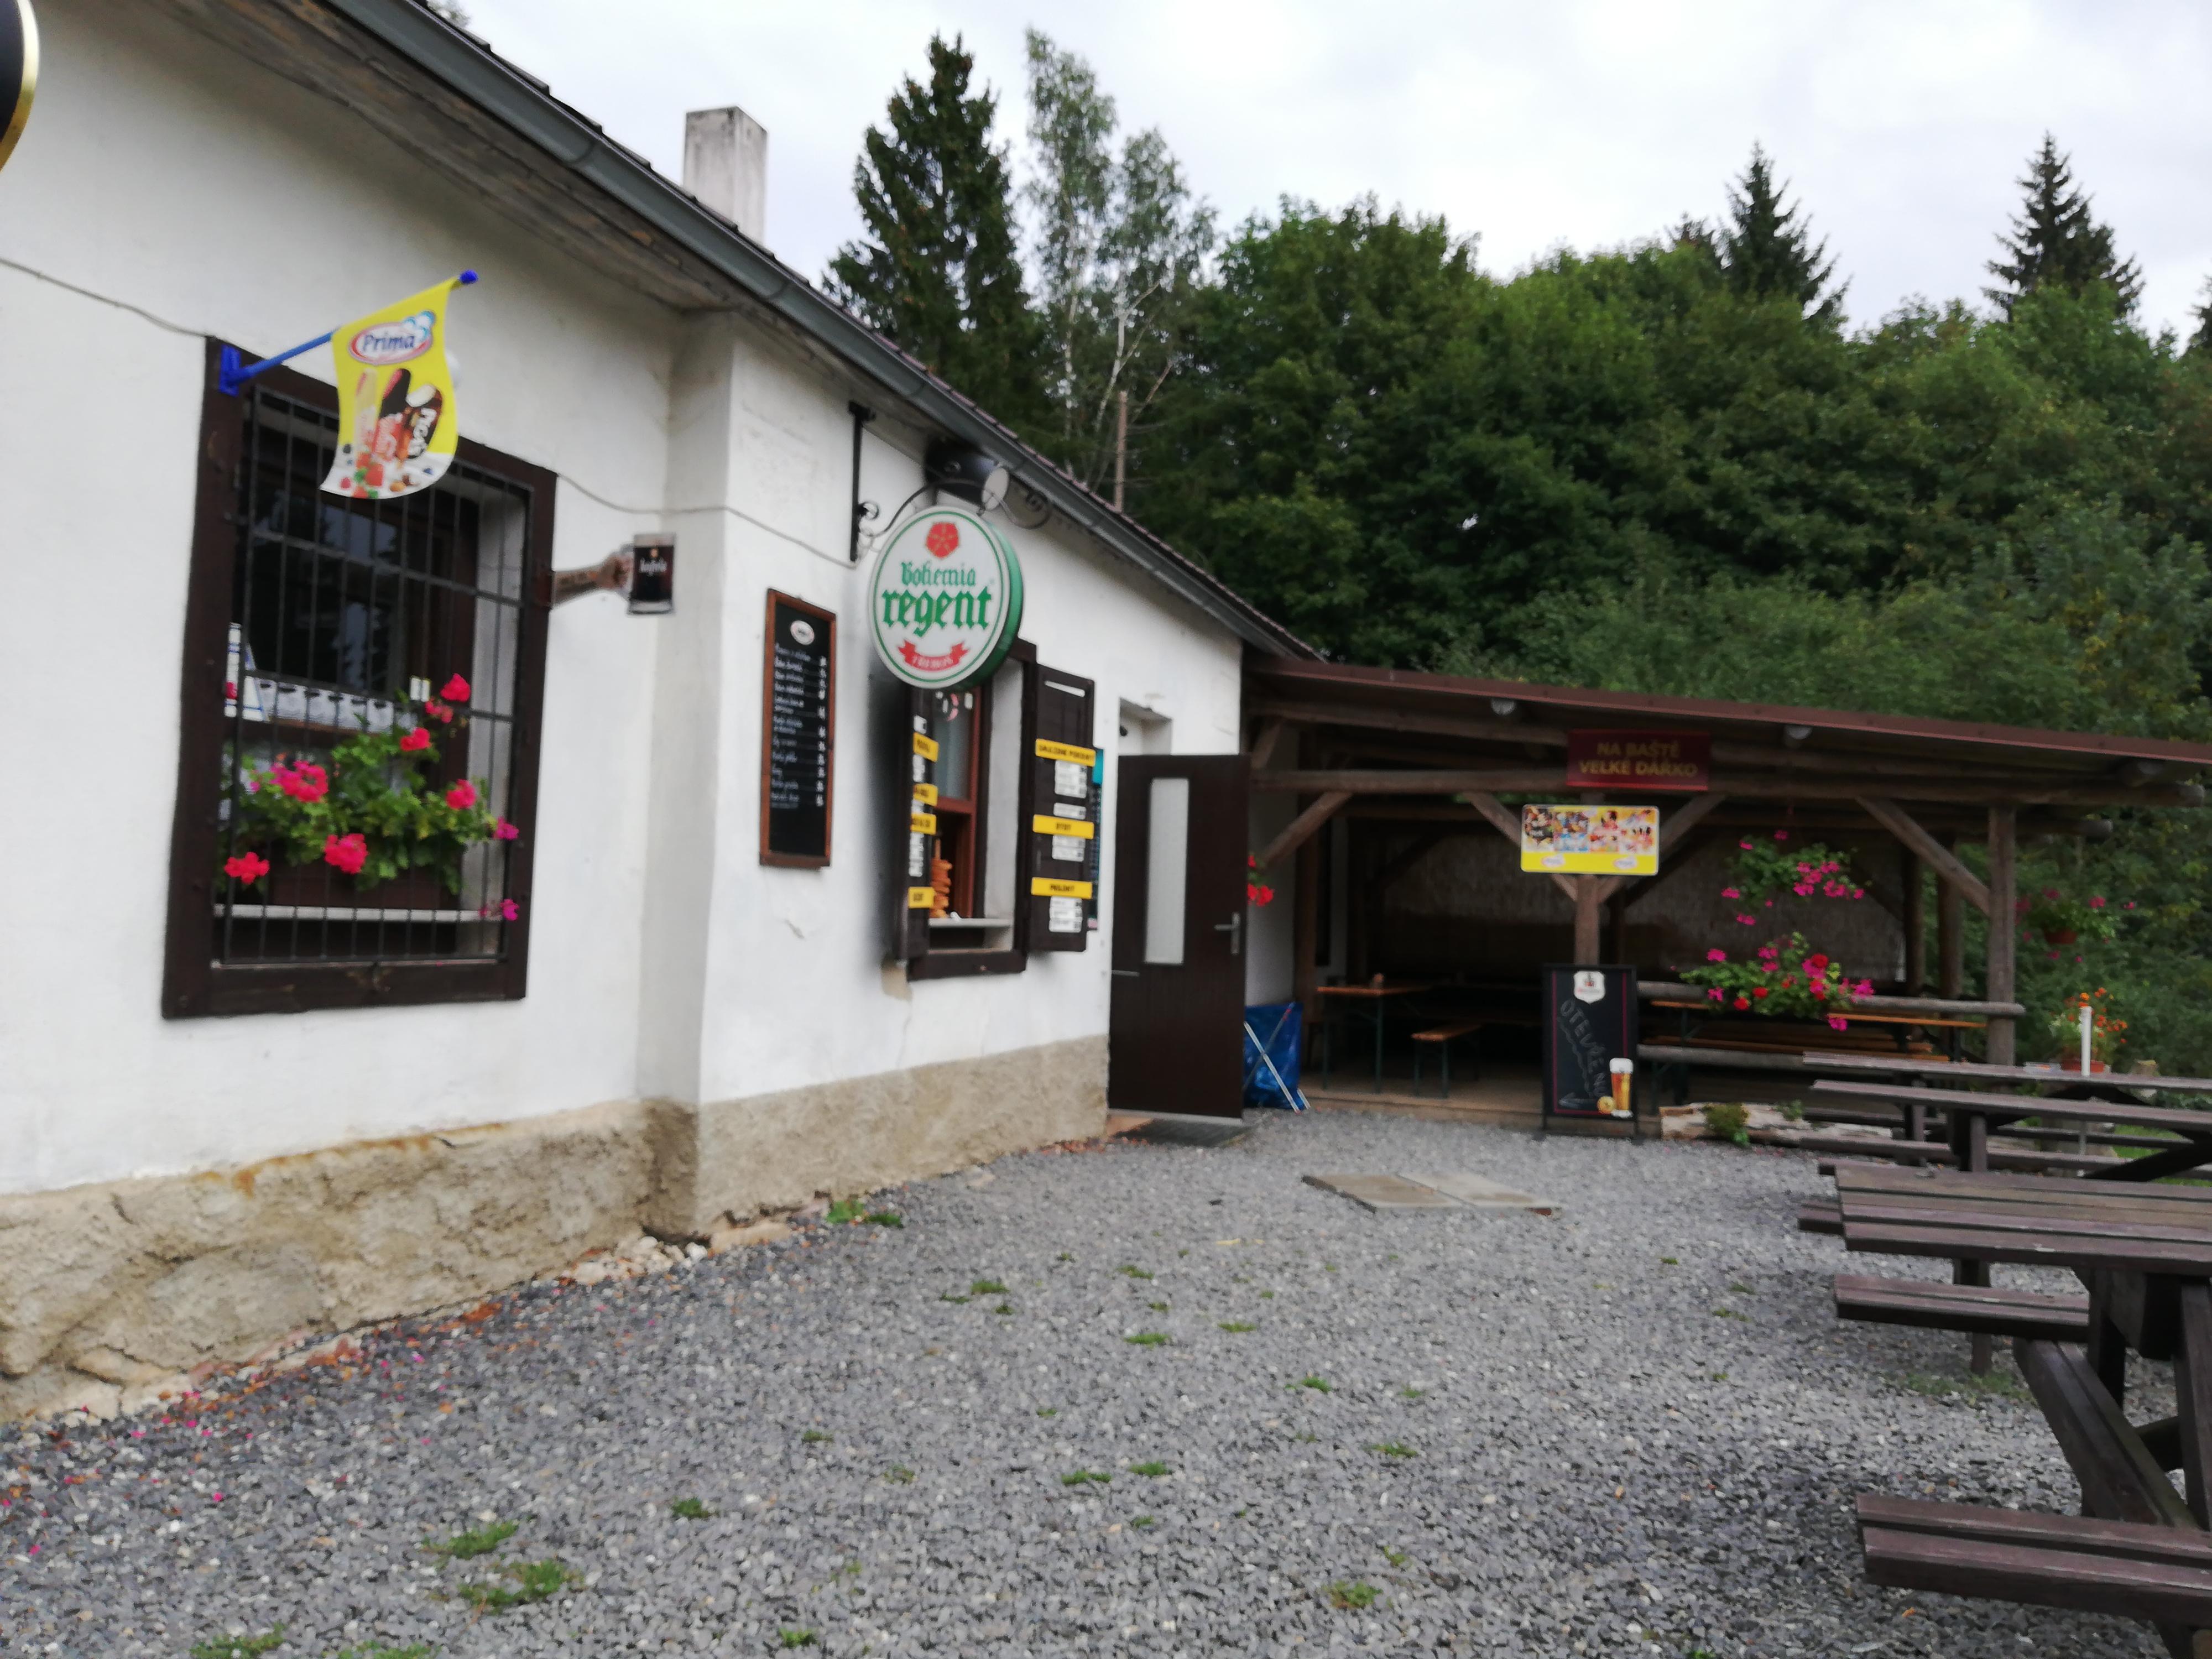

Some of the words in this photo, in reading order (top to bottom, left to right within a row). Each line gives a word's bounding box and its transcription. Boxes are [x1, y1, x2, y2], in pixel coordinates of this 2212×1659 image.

[362, 331, 415, 352] Prima
[881, 586, 992, 637] regent
[1597, 742, 1621, 756] NA
